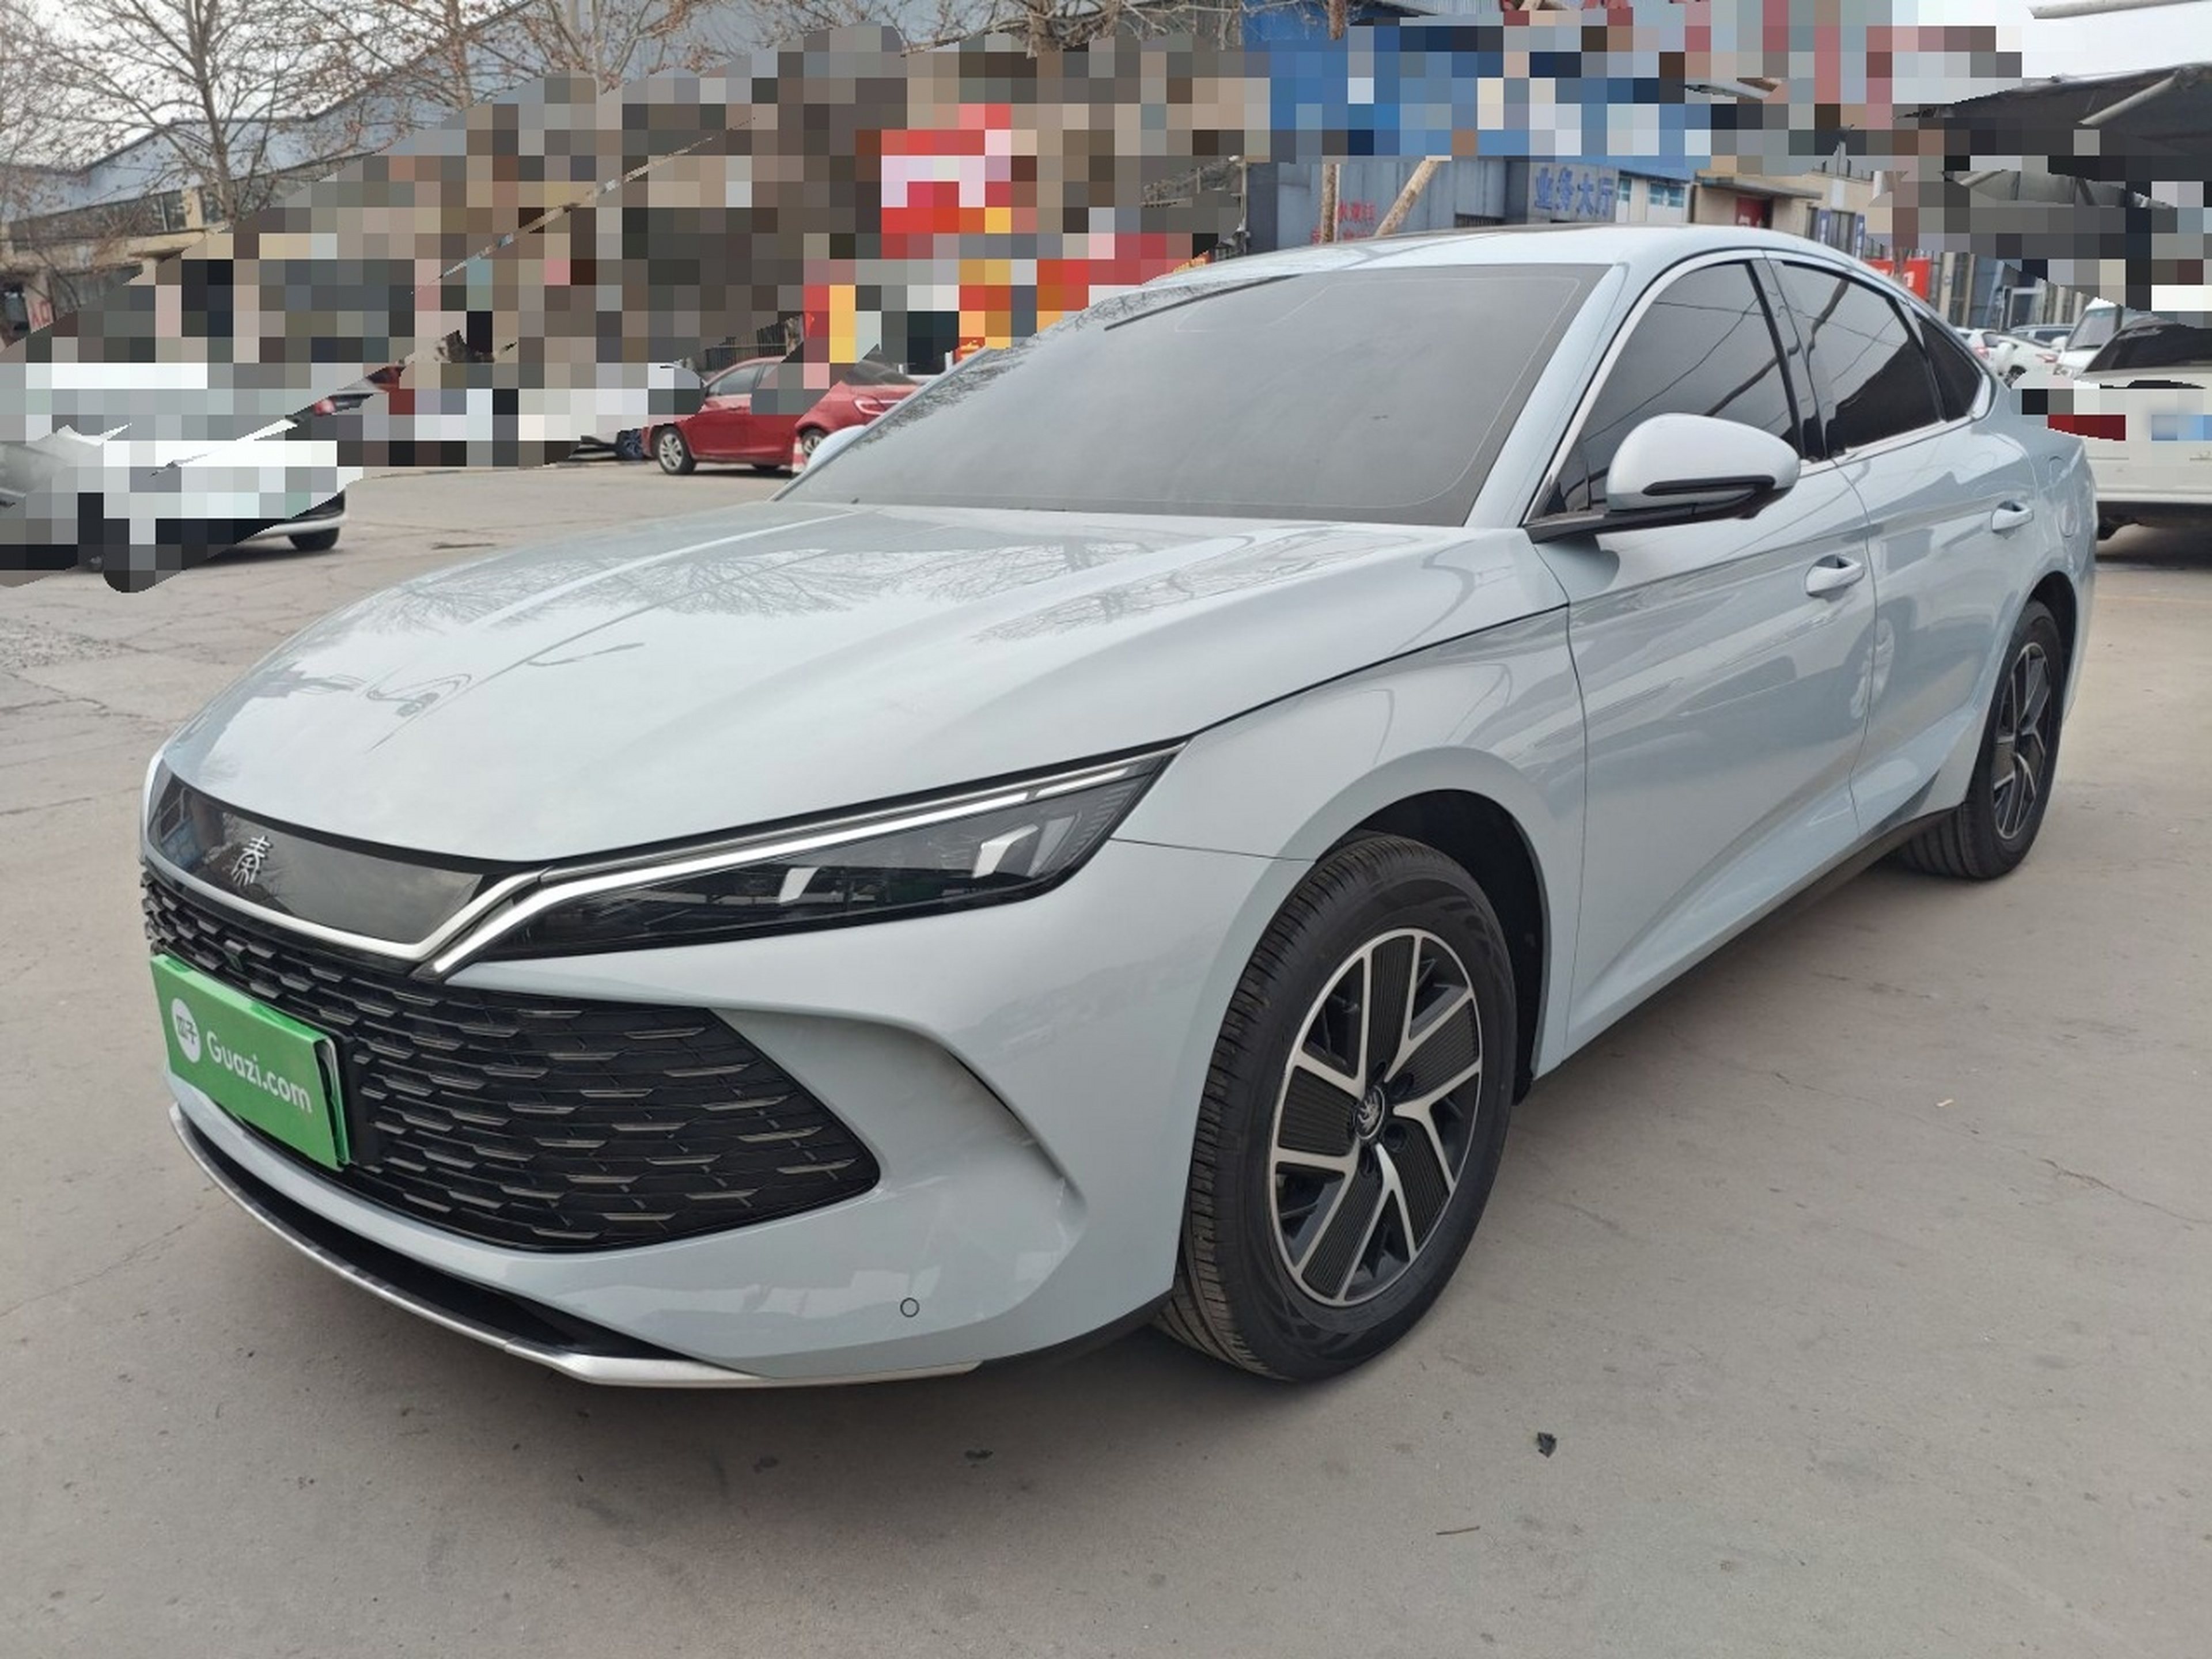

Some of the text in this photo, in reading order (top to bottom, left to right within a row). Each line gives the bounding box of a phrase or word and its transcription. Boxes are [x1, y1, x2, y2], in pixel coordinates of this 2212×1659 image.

[1535, 166, 1613, 216] 业务大厅
[206, 1030, 313, 1113] Guazi.com
